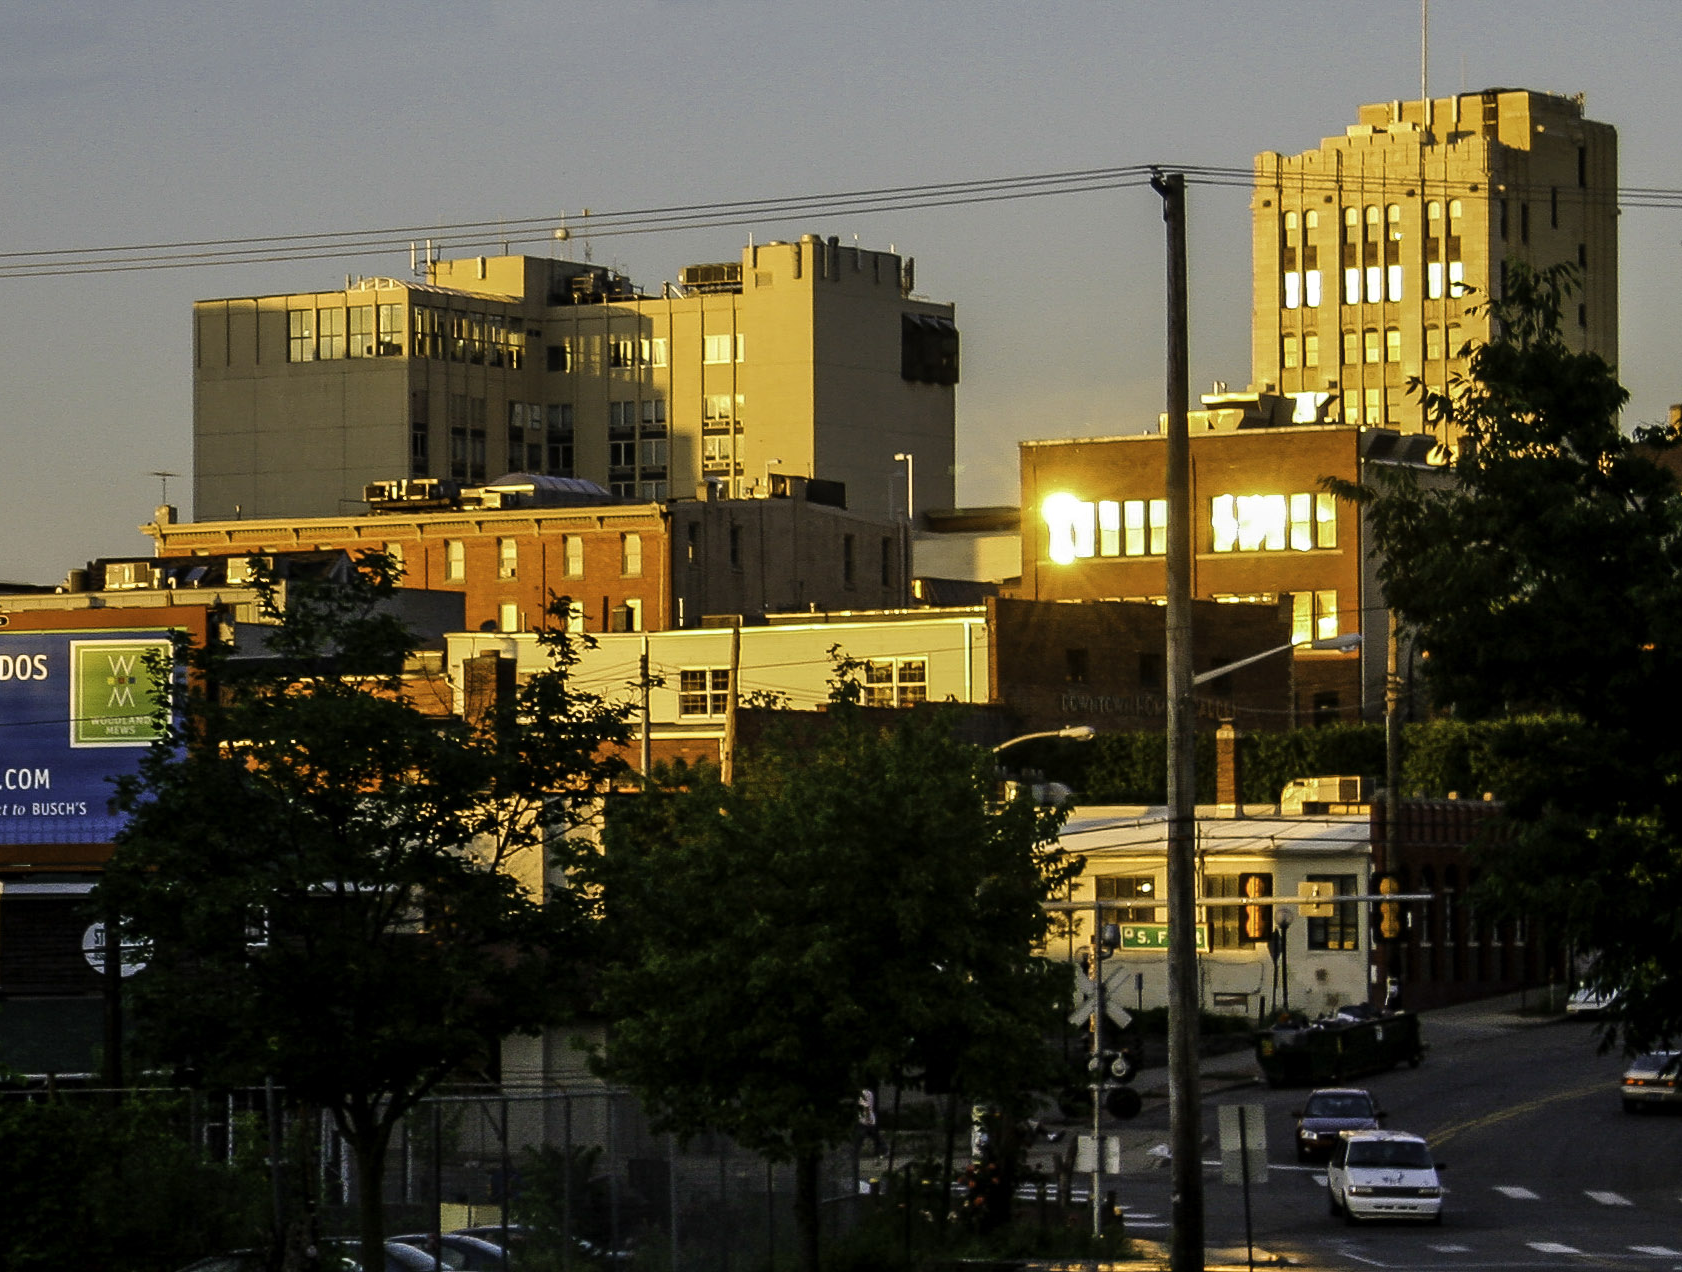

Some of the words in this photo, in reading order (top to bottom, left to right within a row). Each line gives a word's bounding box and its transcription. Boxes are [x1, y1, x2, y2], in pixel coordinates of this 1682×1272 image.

[108, 655, 136, 676] W
[108, 686, 135, 708] M
[105, 725, 136, 735] MEWS
[12, 804, 26, 816] to
[32, 801, 87, 816] BUSCH'S
[1137, 930, 1151, 945] S.
